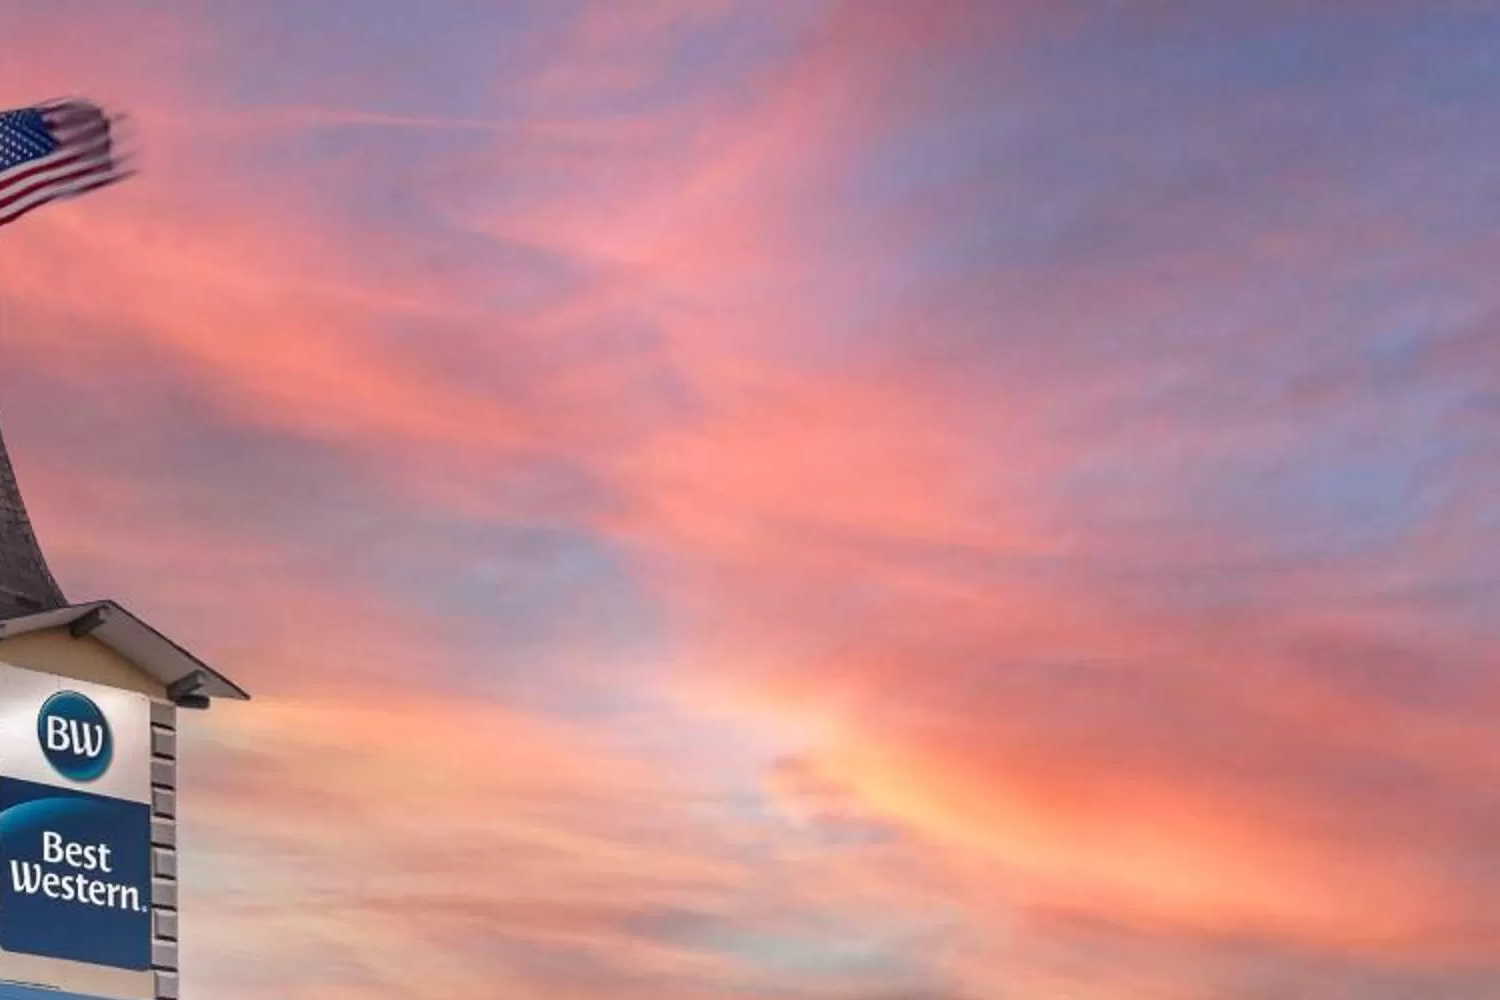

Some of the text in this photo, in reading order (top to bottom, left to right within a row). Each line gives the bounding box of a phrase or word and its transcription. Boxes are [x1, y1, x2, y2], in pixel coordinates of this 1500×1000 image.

[46, 714, 104, 758] BW
[43, 831, 112, 873] Best
[10, 859, 140, 911] Western
